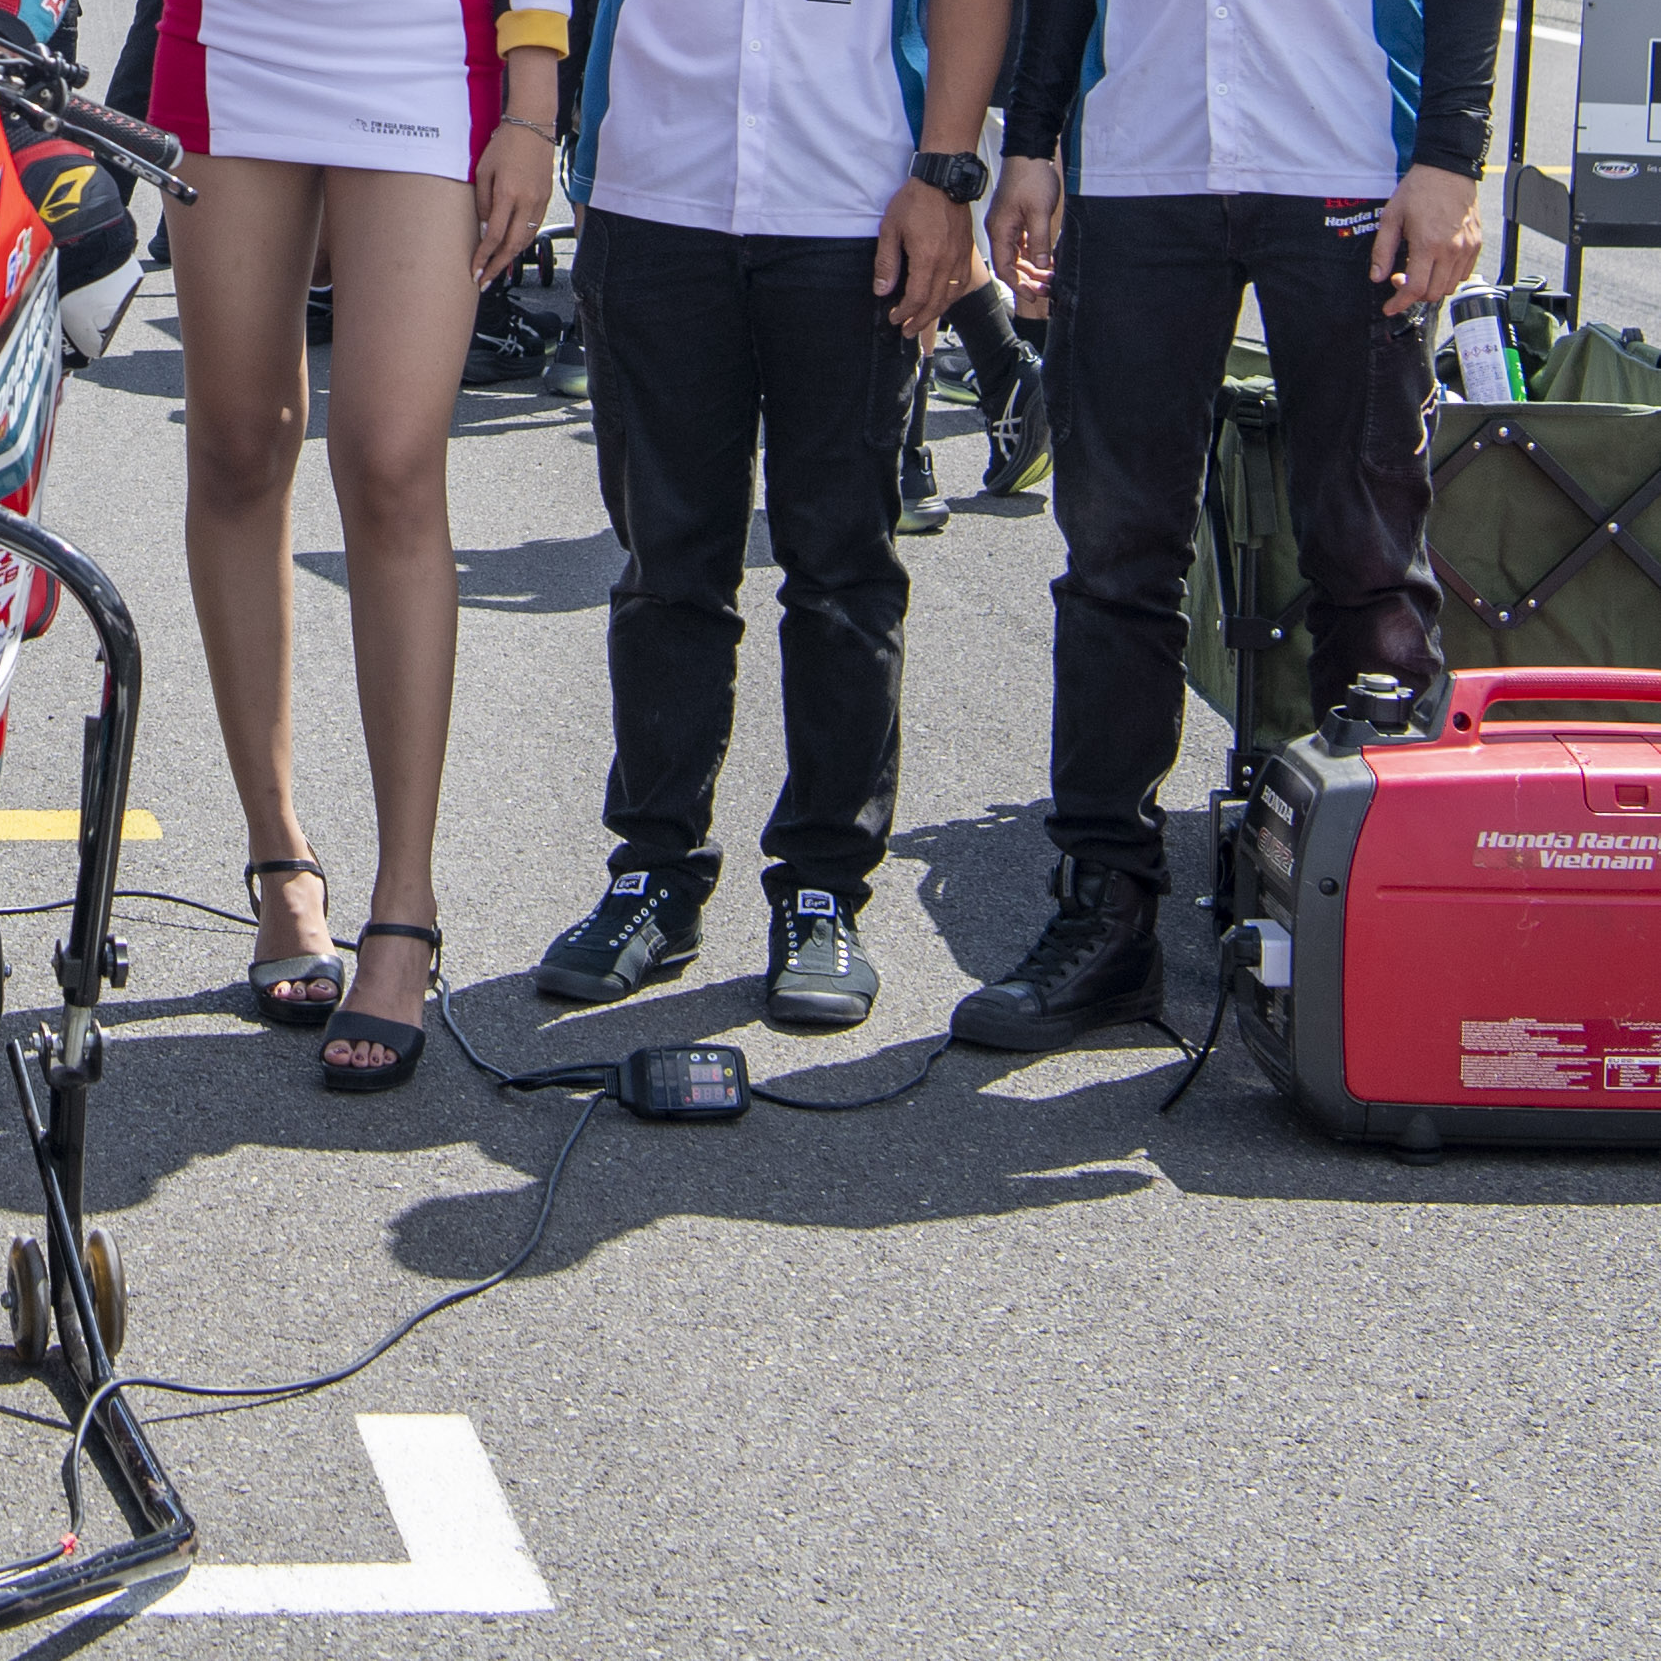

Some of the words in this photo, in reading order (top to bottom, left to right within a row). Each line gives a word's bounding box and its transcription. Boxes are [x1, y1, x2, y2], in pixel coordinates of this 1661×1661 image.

[1325, 210, 1373, 228] Honda
[1261, 784, 1294, 827] HONDA
[1477, 831, 1574, 849] Honda
[1577, 832, 1661, 855] Racin
[1540, 850, 1654, 870] Vietnam
